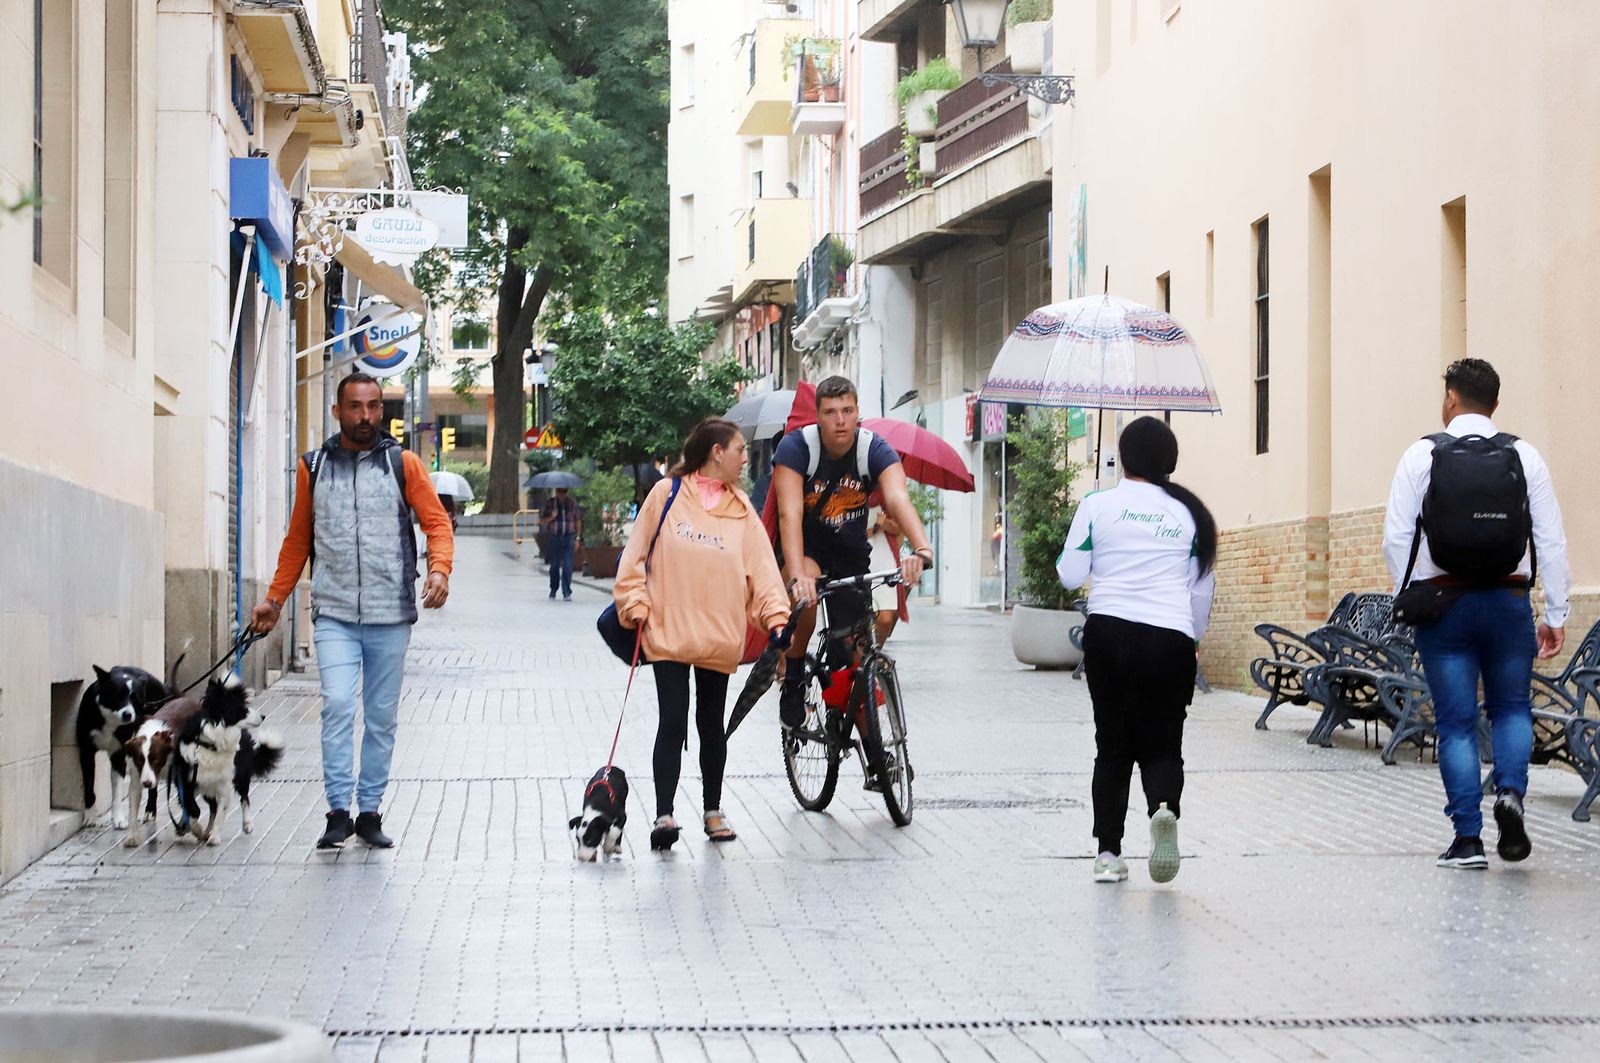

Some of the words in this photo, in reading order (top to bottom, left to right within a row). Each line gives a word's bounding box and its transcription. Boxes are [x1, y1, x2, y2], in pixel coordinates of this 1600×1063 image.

[372, 217, 422, 232] GAUDI
[369, 325, 409, 341] Snell
[1114, 508, 1165, 523] Amenaza
[1154, 523, 1182, 538] Verde
